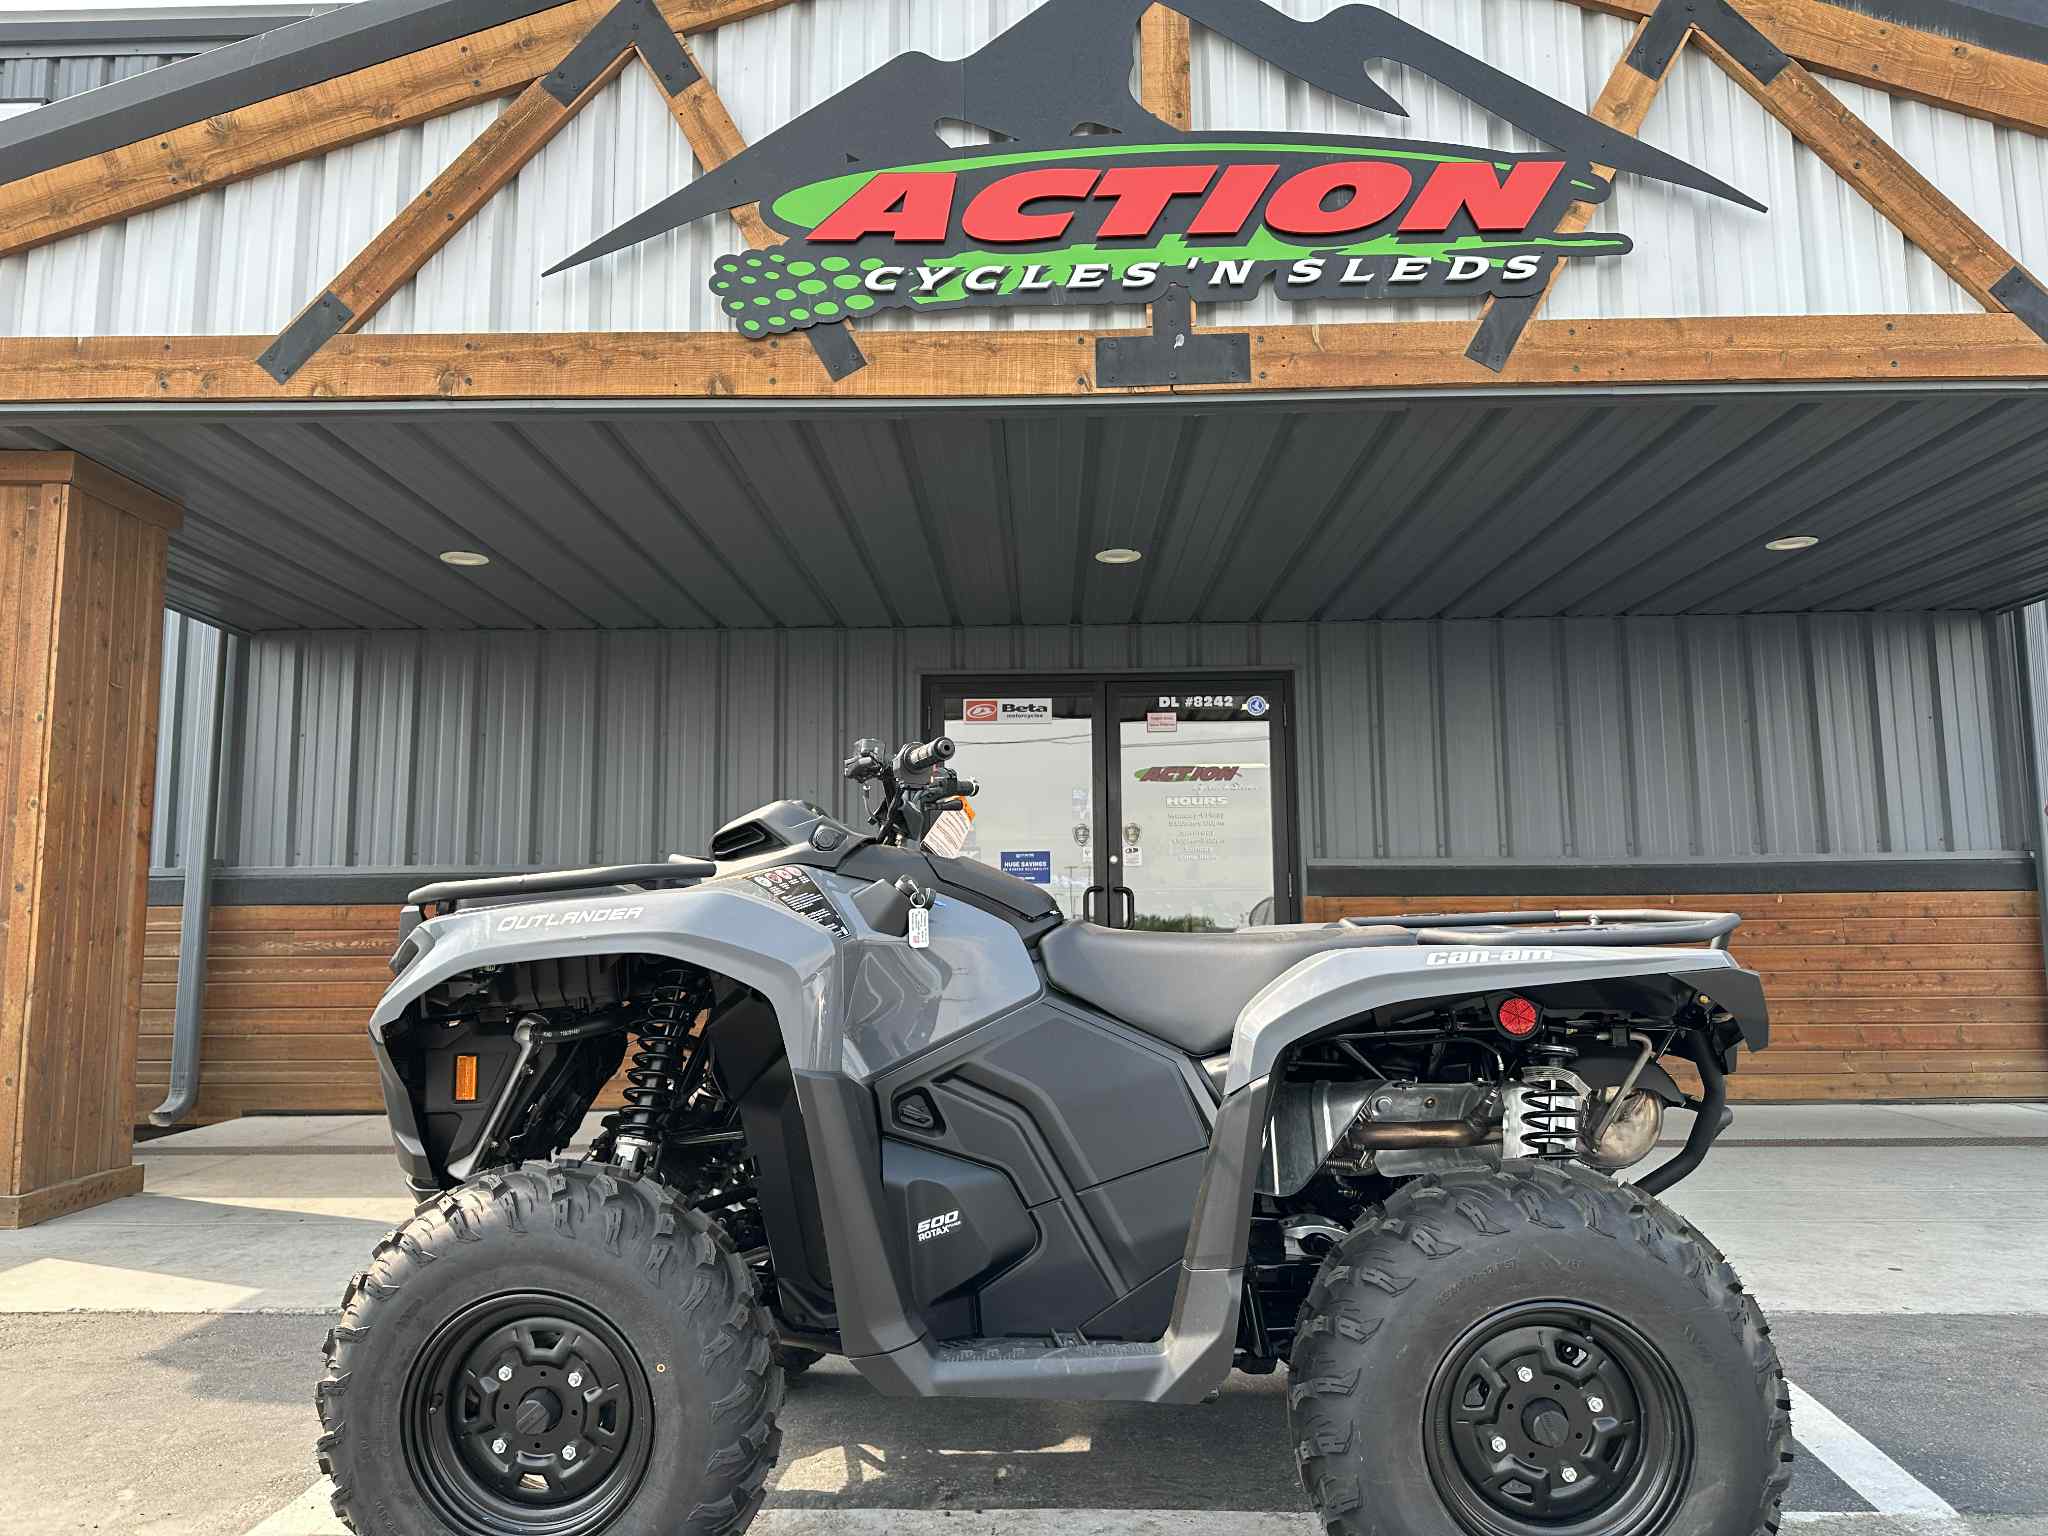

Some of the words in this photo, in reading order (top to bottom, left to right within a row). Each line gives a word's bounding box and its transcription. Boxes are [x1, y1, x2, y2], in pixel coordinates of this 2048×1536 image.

[805, 161, 1566, 242] ACTION
[864, 262, 1161, 291] CYCLES
[1287, 255, 1541, 284] SLEDS
[1002, 704, 1048, 712] Beta
[1159, 696, 1179, 707] DL
[1184, 695, 1233, 707] #8242
[1140, 766, 1240, 781] ACTION
[1166, 796, 1228, 807] HOURS
[497, 907, 644, 931] OUTLANDER
[918, 1225, 950, 1241] ROTAX
